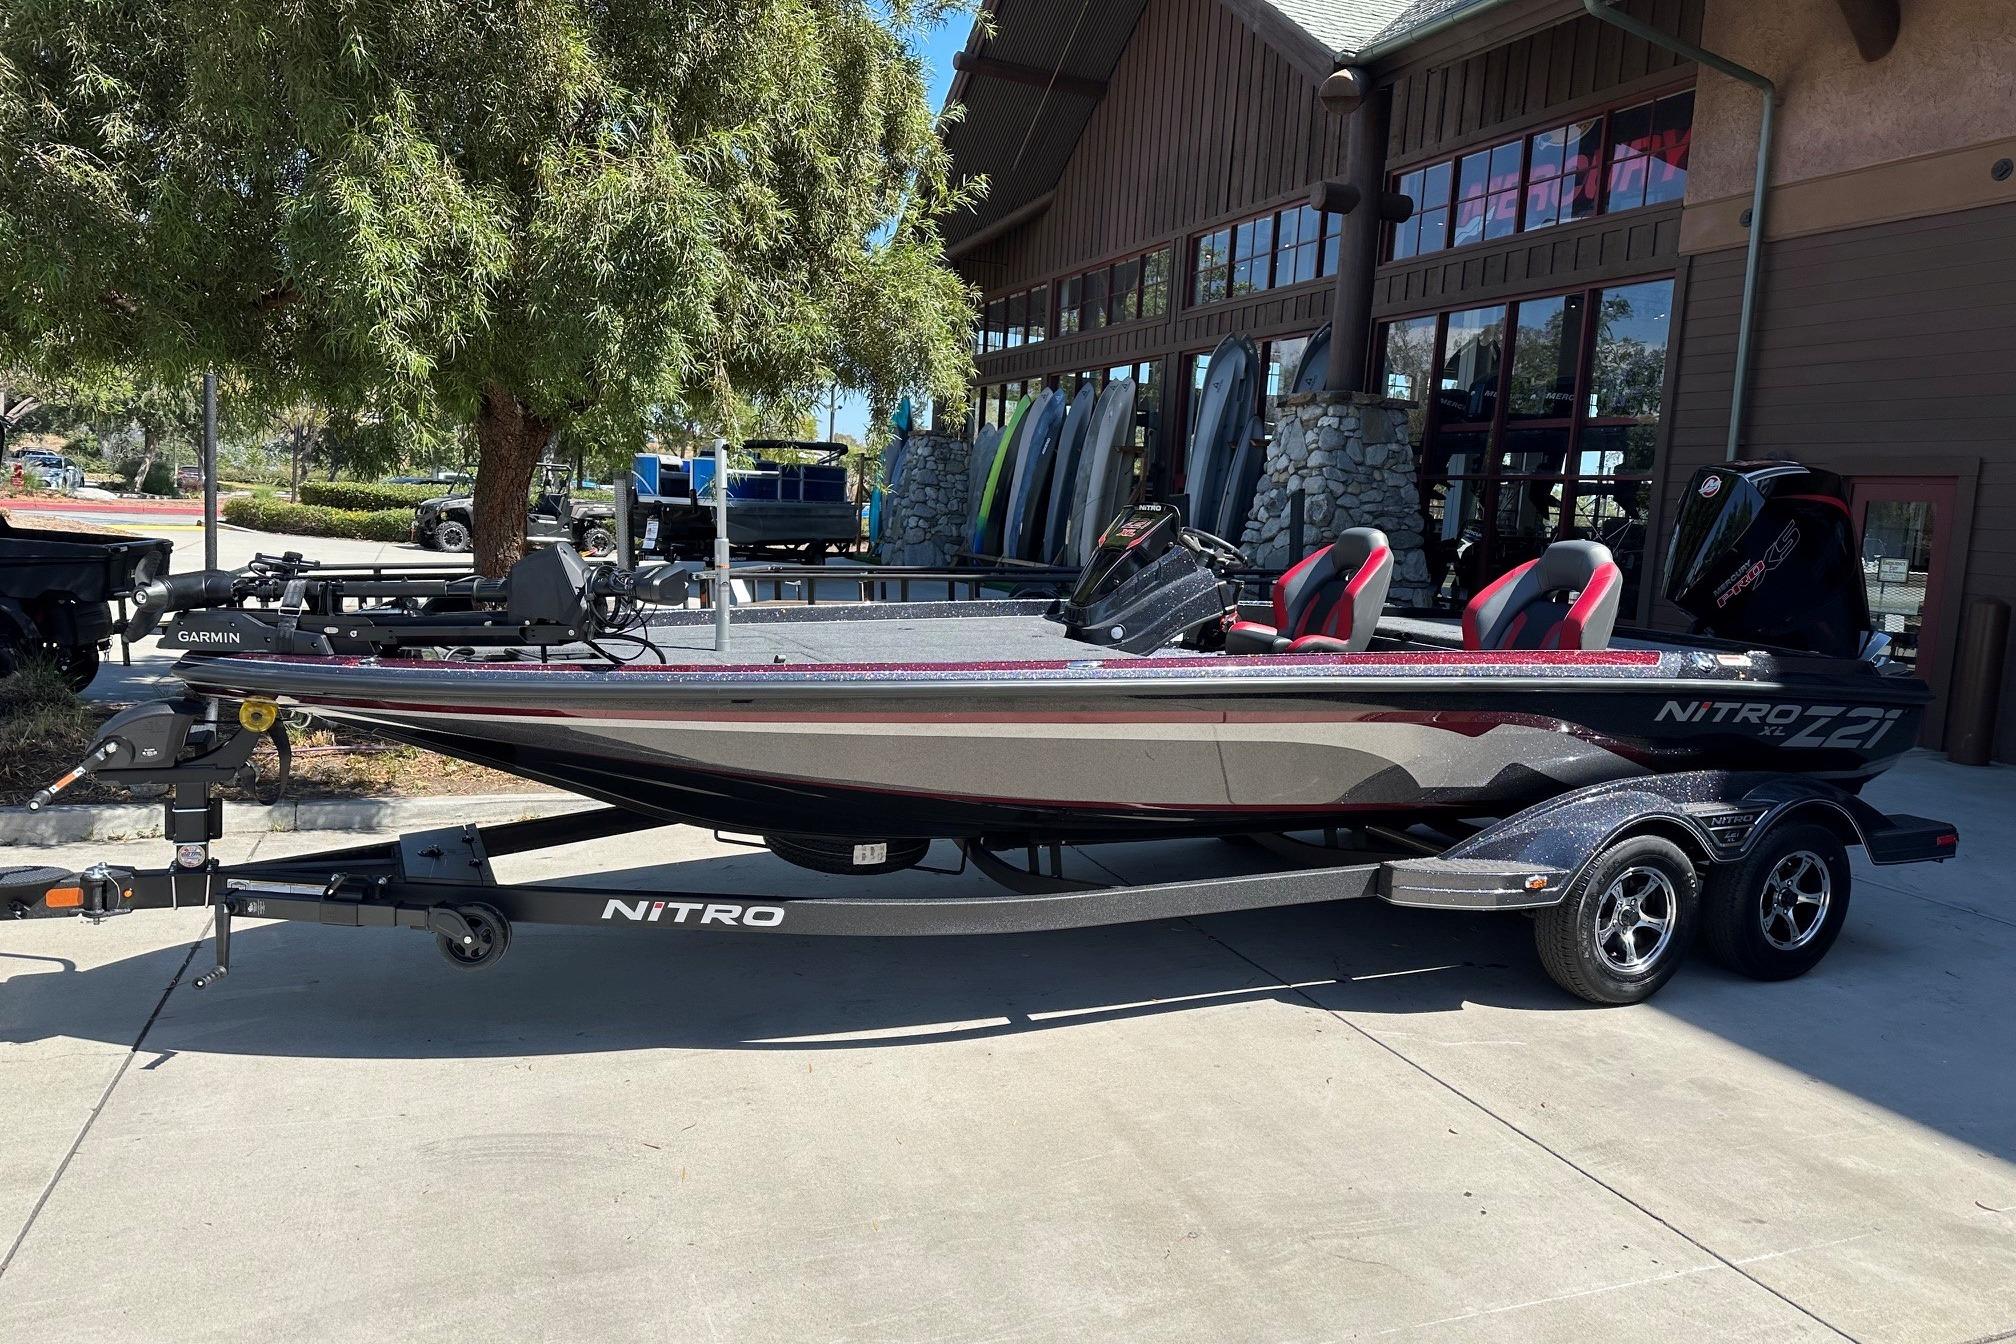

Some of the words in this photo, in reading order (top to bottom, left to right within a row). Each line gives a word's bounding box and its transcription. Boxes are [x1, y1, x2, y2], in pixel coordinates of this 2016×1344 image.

[1460, 127, 1691, 224] MERCURY
[1138, 504, 1162, 512] NITRO
[1717, 560, 1766, 608] PRO
[1752, 519, 1801, 591] XS
[1713, 559, 1751, 597] MERCURY
[178, 631, 240, 644] GARMIN
[1654, 700, 1803, 725] NITRO
[1779, 705, 1903, 749] Z21
[1757, 725, 1787, 736] XL
[1711, 814, 1754, 826] NITRO
[601, 899, 785, 927] NITRO
